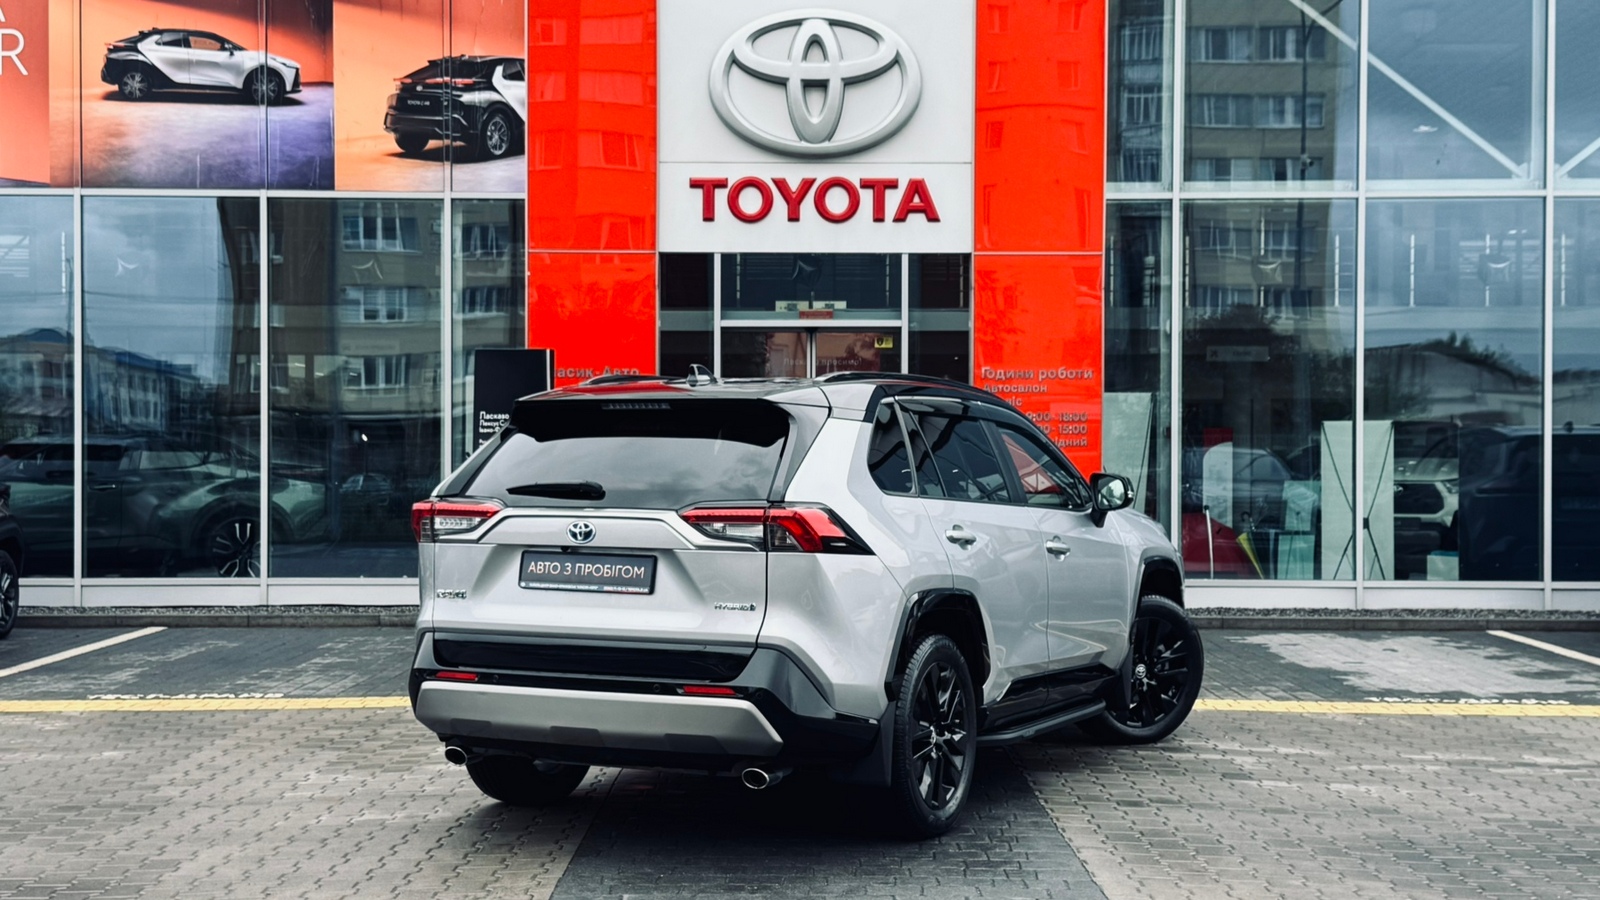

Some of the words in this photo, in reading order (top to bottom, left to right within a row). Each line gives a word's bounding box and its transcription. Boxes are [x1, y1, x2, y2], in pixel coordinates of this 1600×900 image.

[689, 176, 941, 223] TOYOTA
[555, 366, 640, 378] асик-Авто
[981, 366, 1034, 380] Години
[1038, 366, 1093, 381] роботи
[983, 384, 1047, 393] Автосалон
[1053, 437, 1087, 447] ідний
[528, 561, 561, 575] АВТО
[563, 562, 572, 575] З
[575, 563, 645, 579] ПРОБІГОМ
